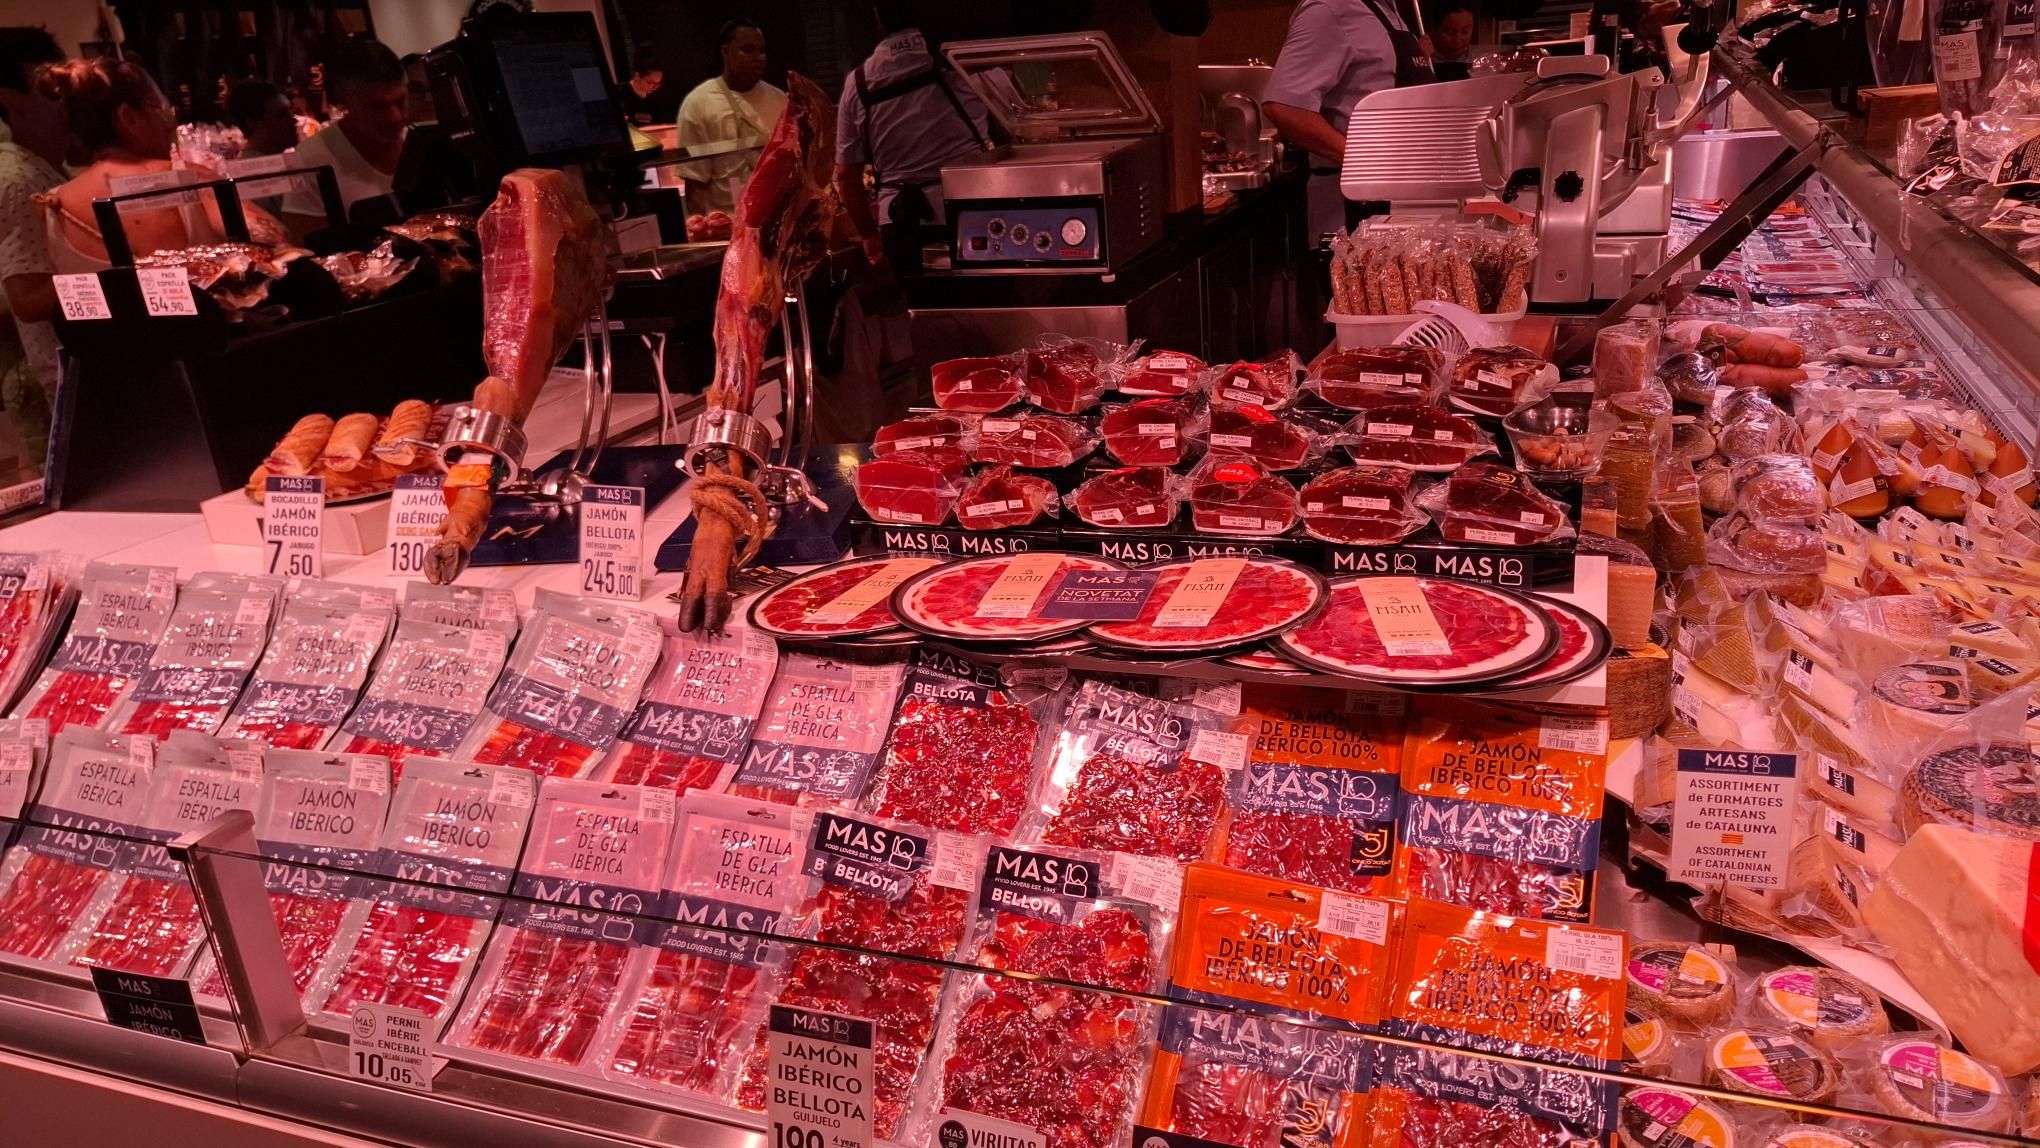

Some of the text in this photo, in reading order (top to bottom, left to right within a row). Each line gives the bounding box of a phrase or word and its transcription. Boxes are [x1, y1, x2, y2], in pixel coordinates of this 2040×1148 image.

[280, 478, 303, 489] MAS
[413, 477, 438, 487] MAS
[271, 495, 318, 504] BOCADILLO
[598, 488, 621, 500] MAS
[272, 507, 317, 521] JAMÓN
[586, 507, 628, 522] JAMÓN
[268, 523, 319, 538] IBÉRICO
[586, 525, 636, 541] BELLOTA
[885, 532, 928, 550] MAS
[962, 537, 1005, 554] MAS
[1101, 542, 1150, 560] MAS
[390, 542, 424, 572] 130
[1334, 551, 1388, 572] MAS
[1435, 555, 1493, 576] MAS
[1077, 576, 1125, 585] MAS
[100, 594, 151, 612] ESPATLLA
[1063, 589, 1146, 598] NOVETAT
[185, 623, 243, 639] ESPATLLA
[69, 640, 121, 666] MAS
[687, 650, 743, 669] ESPATLLA
[918, 650, 973, 675] MAS
[686, 666, 732, 686] DE GLA
[916, 668, 948, 679] FOOD LOVERS
[790, 684, 856, 705] ESPATLLA
[914, 682, 976, 702] BELLOTA
[516, 693, 583, 732] MAS
[791, 703, 844, 722] DE GLA
[1099, 699, 1156, 733] MAS
[369, 708, 433, 741] MAS
[640, 707, 704, 741] MAS
[1095, 722, 1109, 730] FOOD
[1260, 719, 1290, 738] DE
[1294, 723, 1371, 744] BELLOTA
[1105, 736, 1169, 765] BELLOTA
[1332, 741, 1378, 760] 100%
[1470, 740, 1542, 762] JAMÓN
[1705, 752, 1749, 768] MAS
[744, 744, 821, 780] MAS
[1442, 753, 1563, 780] DE BELLOTA
[79, 761, 137, 788] ESPATLLA
[1250, 768, 1329, 800] MAS
[1429, 765, 1574, 802] IBÉRICO 100%
[178, 780, 241, 803] ESPATLLA
[1689, 778, 1781, 794] ASSORTIMENT
[297, 784, 357, 810] JAMÓN
[1688, 793, 1784, 808] de FORMATGES
[434, 796, 497, 825] JAMÓN
[1699, 807, 1767, 821] ARTESANS
[575, 811, 640, 835] ESPATLLA
[1422, 802, 1523, 841] MAS
[1686, 820, 1778, 835] de CATALUNYA
[41, 814, 101, 851] MAS
[720, 828, 793, 857] ESPATLLA
[827, 818, 887, 855] MAS
[1420, 835, 1442, 844] FOOD
[577, 832, 628, 855] DE GLA
[824, 842, 882, 863] FOOD LOVERS EST. 1945
[1695, 845, 1768, 860] ASSORTMENT
[264, 853, 330, 890] MAS
[721, 850, 778, 877] DE GLA
[997, 851, 1059, 884] MAS
[1688, 858, 1772, 873] OF CATALONIAN
[388, 864, 463, 905] MAS
[834, 862, 900, 895] BELLOTA
[994, 876, 1056, 894] FOOD LOVERS EST. 1945
[1680, 869, 1779, 885] ARTISAN CHEESES
[530, 881, 605, 924] MAS
[991, 887, 1063, 917] BELLOTA
[524, 918, 566, 932] FOOD LOVERS
[671, 899, 755, 948] MAS
[1245, 919, 1323, 951] JAMÓN
[667, 937, 728, 958] FOOD LOVERS EST.
[1217, 937, 1345, 981] DE BELLOTA
[1468, 955, 1552, 982] JAMÓN
[118, 977, 152, 995] MAS
[1297, 972, 1352, 1005] 100%
[1439, 968, 1470, 992] DE
[129, 1003, 174, 1022] JAMÓN
[355, 1016, 374, 1028] MAS
[386, 1015, 422, 1030] PERNIL
[793, 1012, 830, 1033] MAS
[1527, 1002, 1587, 1039] 100%
[1193, 1009, 1295, 1050] MAS
[378, 1039, 428, 1057] ENCEBALL
[782, 1040, 858, 1070] JAMÓN
[355, 1051, 412, 1084] 10,05
[778, 1063, 863, 1095] IBÉRICO
[1440, 1082, 1496, 1101] LOVERS EST.
[774, 1087, 866, 1121] BELLOTA
[793, 1111, 841, 1129] GUIJUELO
[832, 1135, 861, 1148] 4 years
[943, 1128, 965, 1140] MAS
